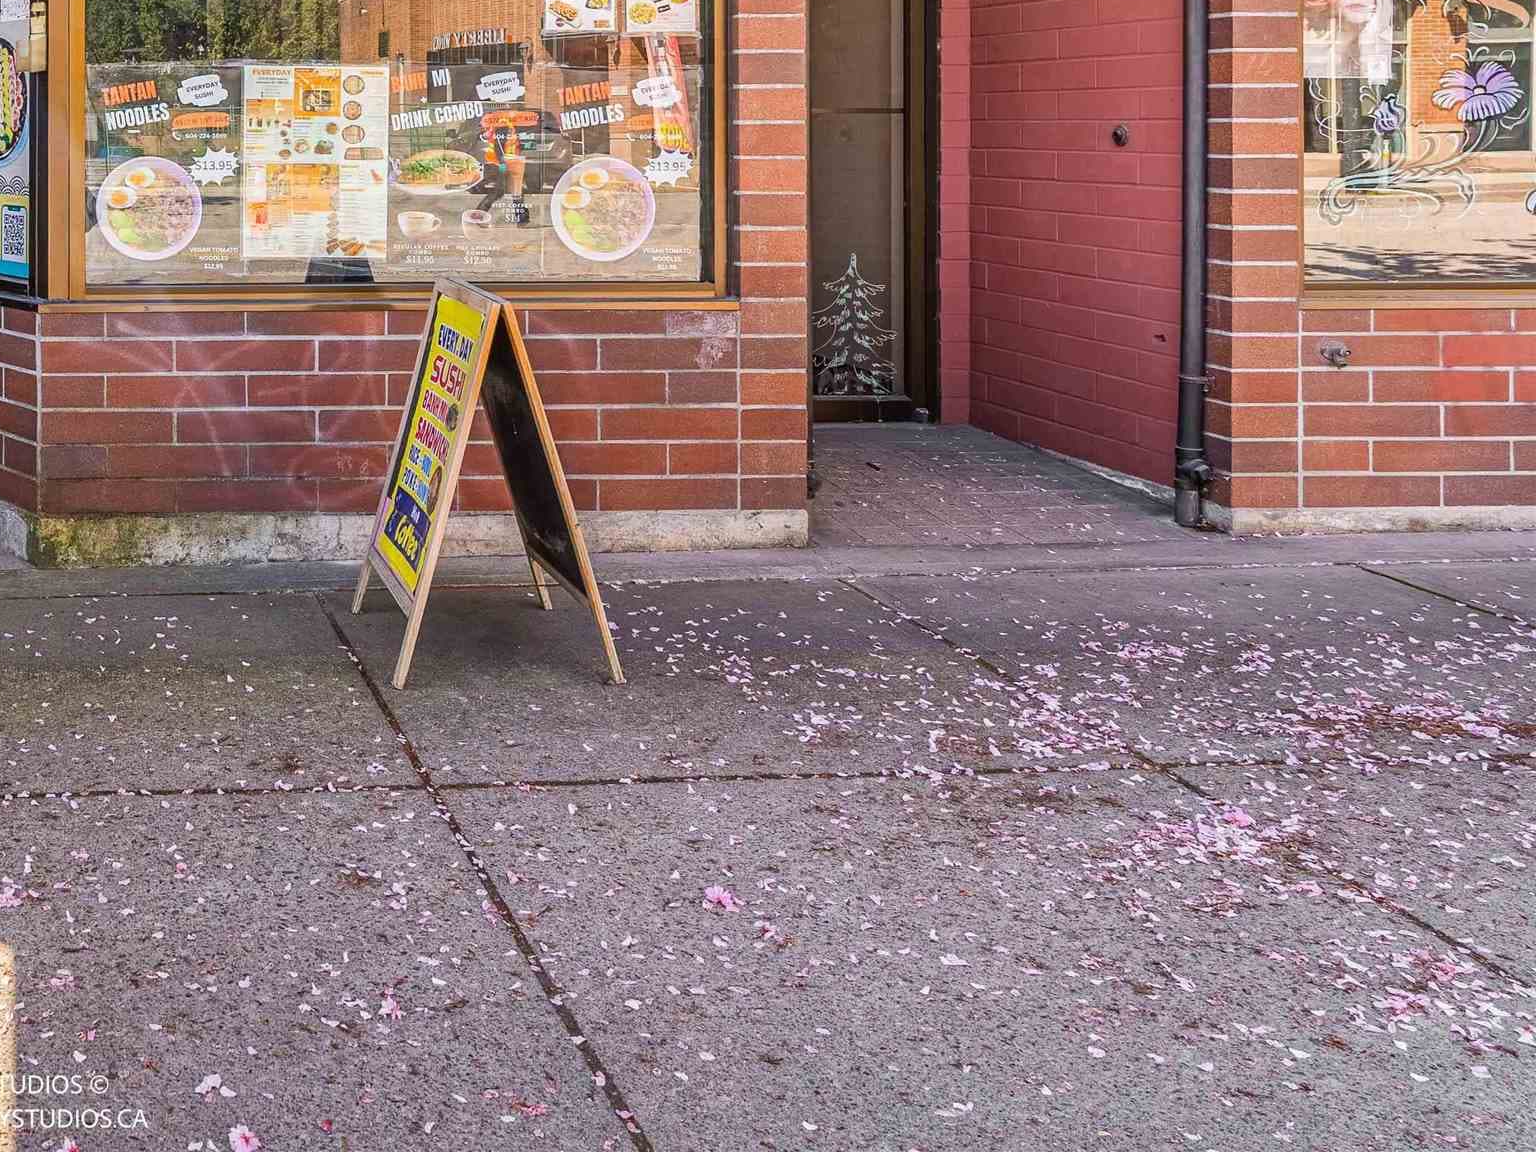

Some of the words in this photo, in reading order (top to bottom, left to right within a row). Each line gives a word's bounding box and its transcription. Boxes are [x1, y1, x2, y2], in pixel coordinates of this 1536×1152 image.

[105, 103, 170, 131] NOODLES
[391, 109, 432, 131] DRINK
[434, 101, 484, 124] COMBO
[559, 103, 624, 131] NOODLES
[195, 160, 233, 171] $13.95
